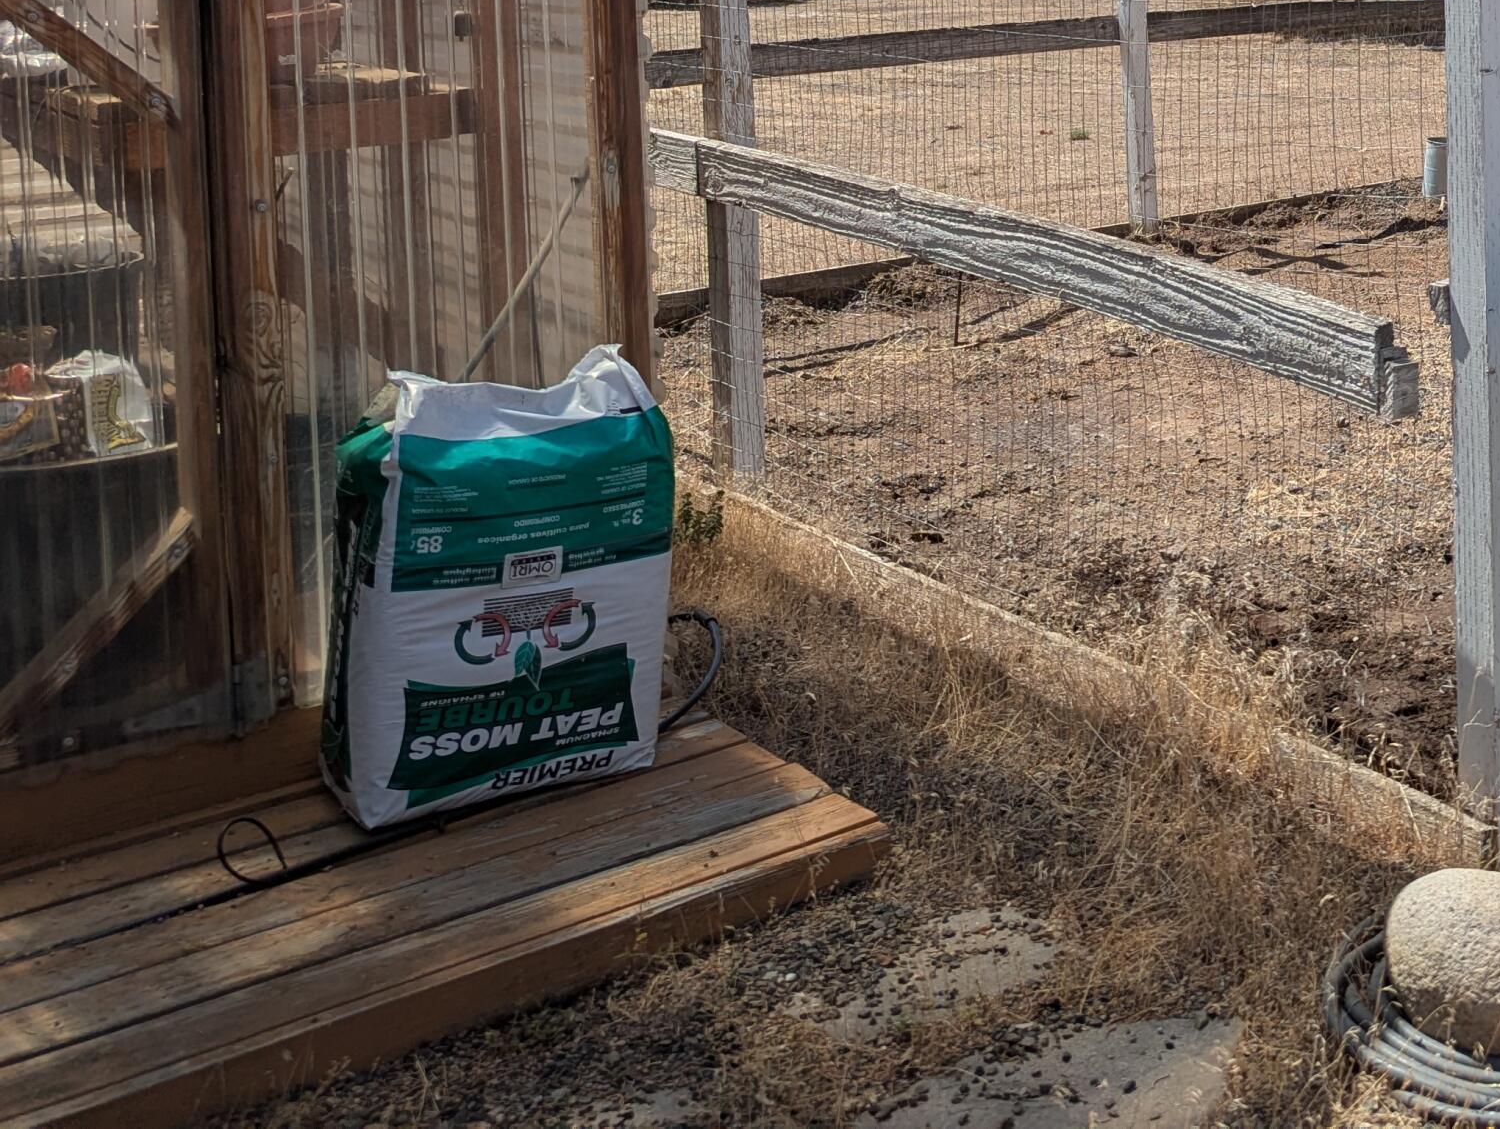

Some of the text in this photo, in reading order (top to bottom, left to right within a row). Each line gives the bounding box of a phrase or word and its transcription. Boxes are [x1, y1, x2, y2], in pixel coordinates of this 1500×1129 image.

[632, 508, 644, 525] 3
[530, 527, 567, 539] cultivos
[512, 561, 554, 577] OMRI
[415, 687, 574, 733] TOURBE
[408, 701, 624, 760] PEAT MOSS
[555, 726, 620, 746] SPHAGNUM
[491, 749, 615, 790] PREMIER
